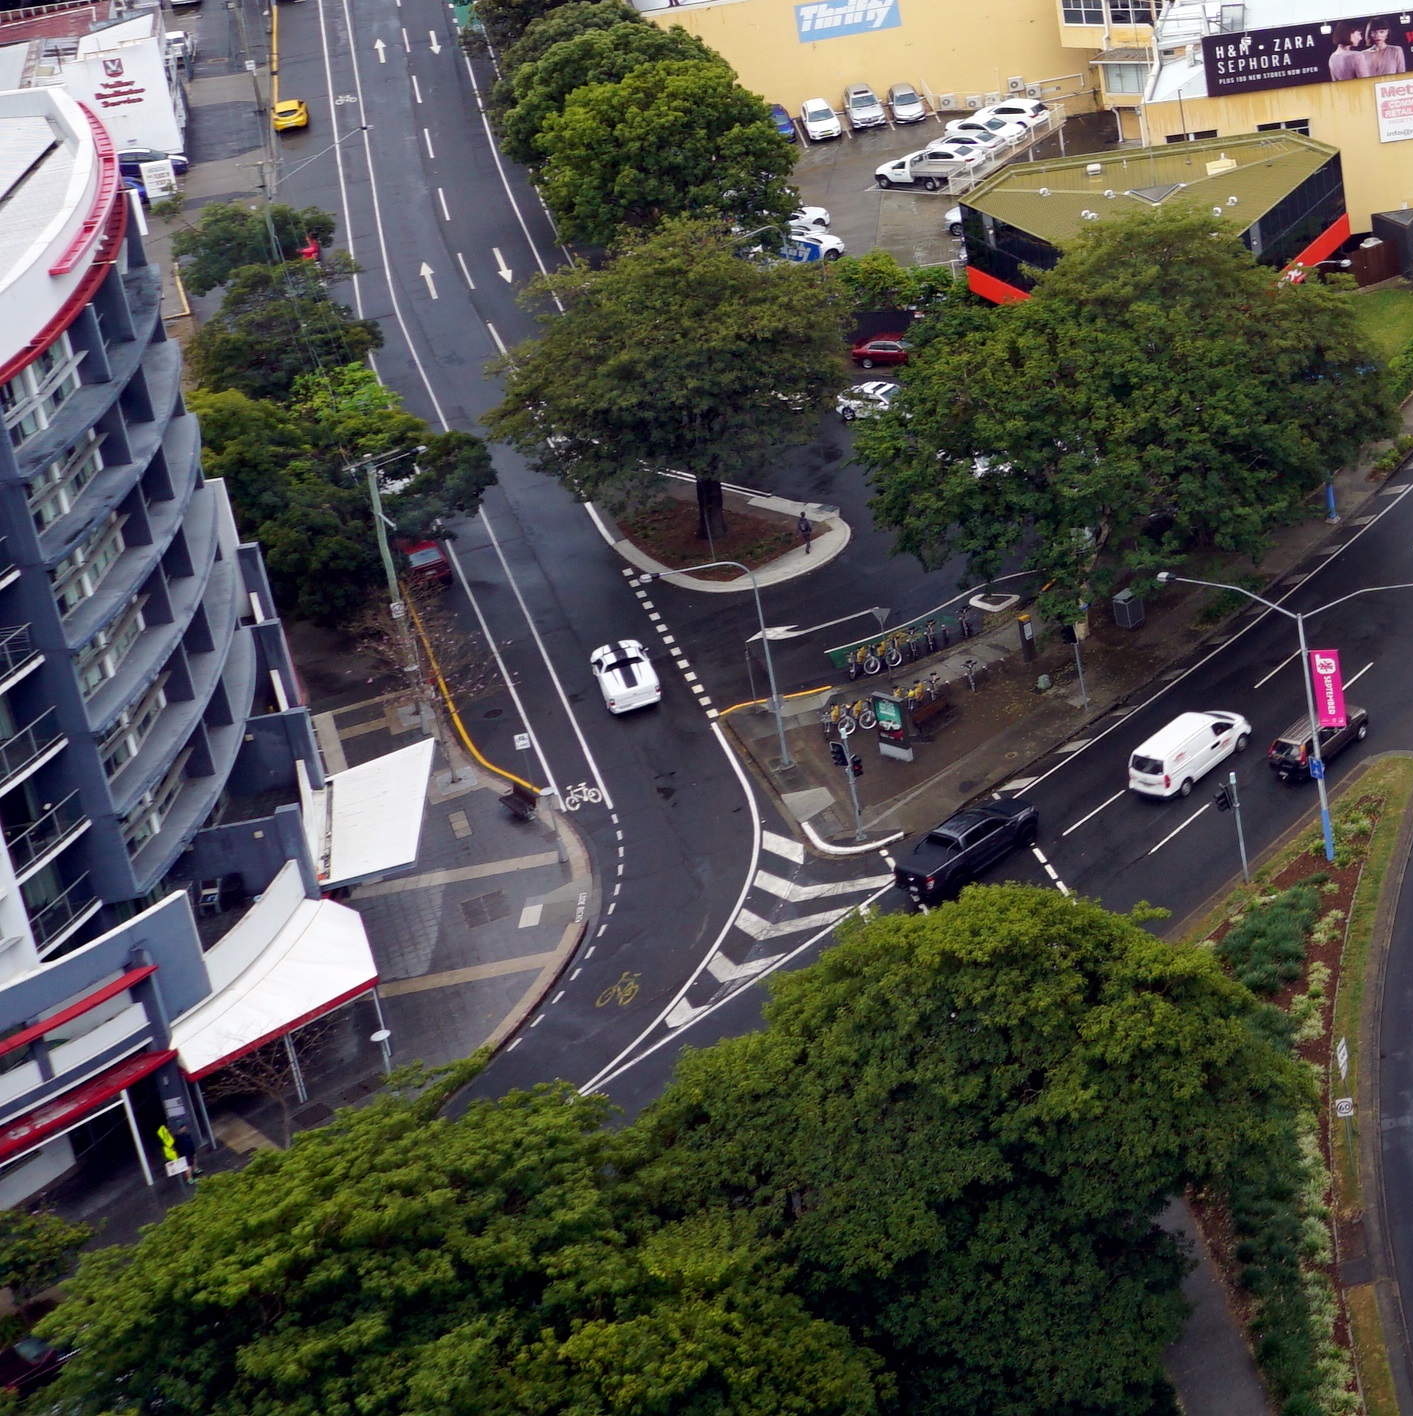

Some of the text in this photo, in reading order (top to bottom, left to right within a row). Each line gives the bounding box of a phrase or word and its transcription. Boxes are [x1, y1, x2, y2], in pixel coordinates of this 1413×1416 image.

[1215, 35, 1315, 59] H&M ZARA
[1217, 53, 1292, 74] SEPHORA
[1263, 71, 1286, 79] STORES
[1302, 66, 1319, 74] OPEN
[1323, 675, 1336, 715] SEPTEMBER
[1339, 1103, 1352, 1112] 60
